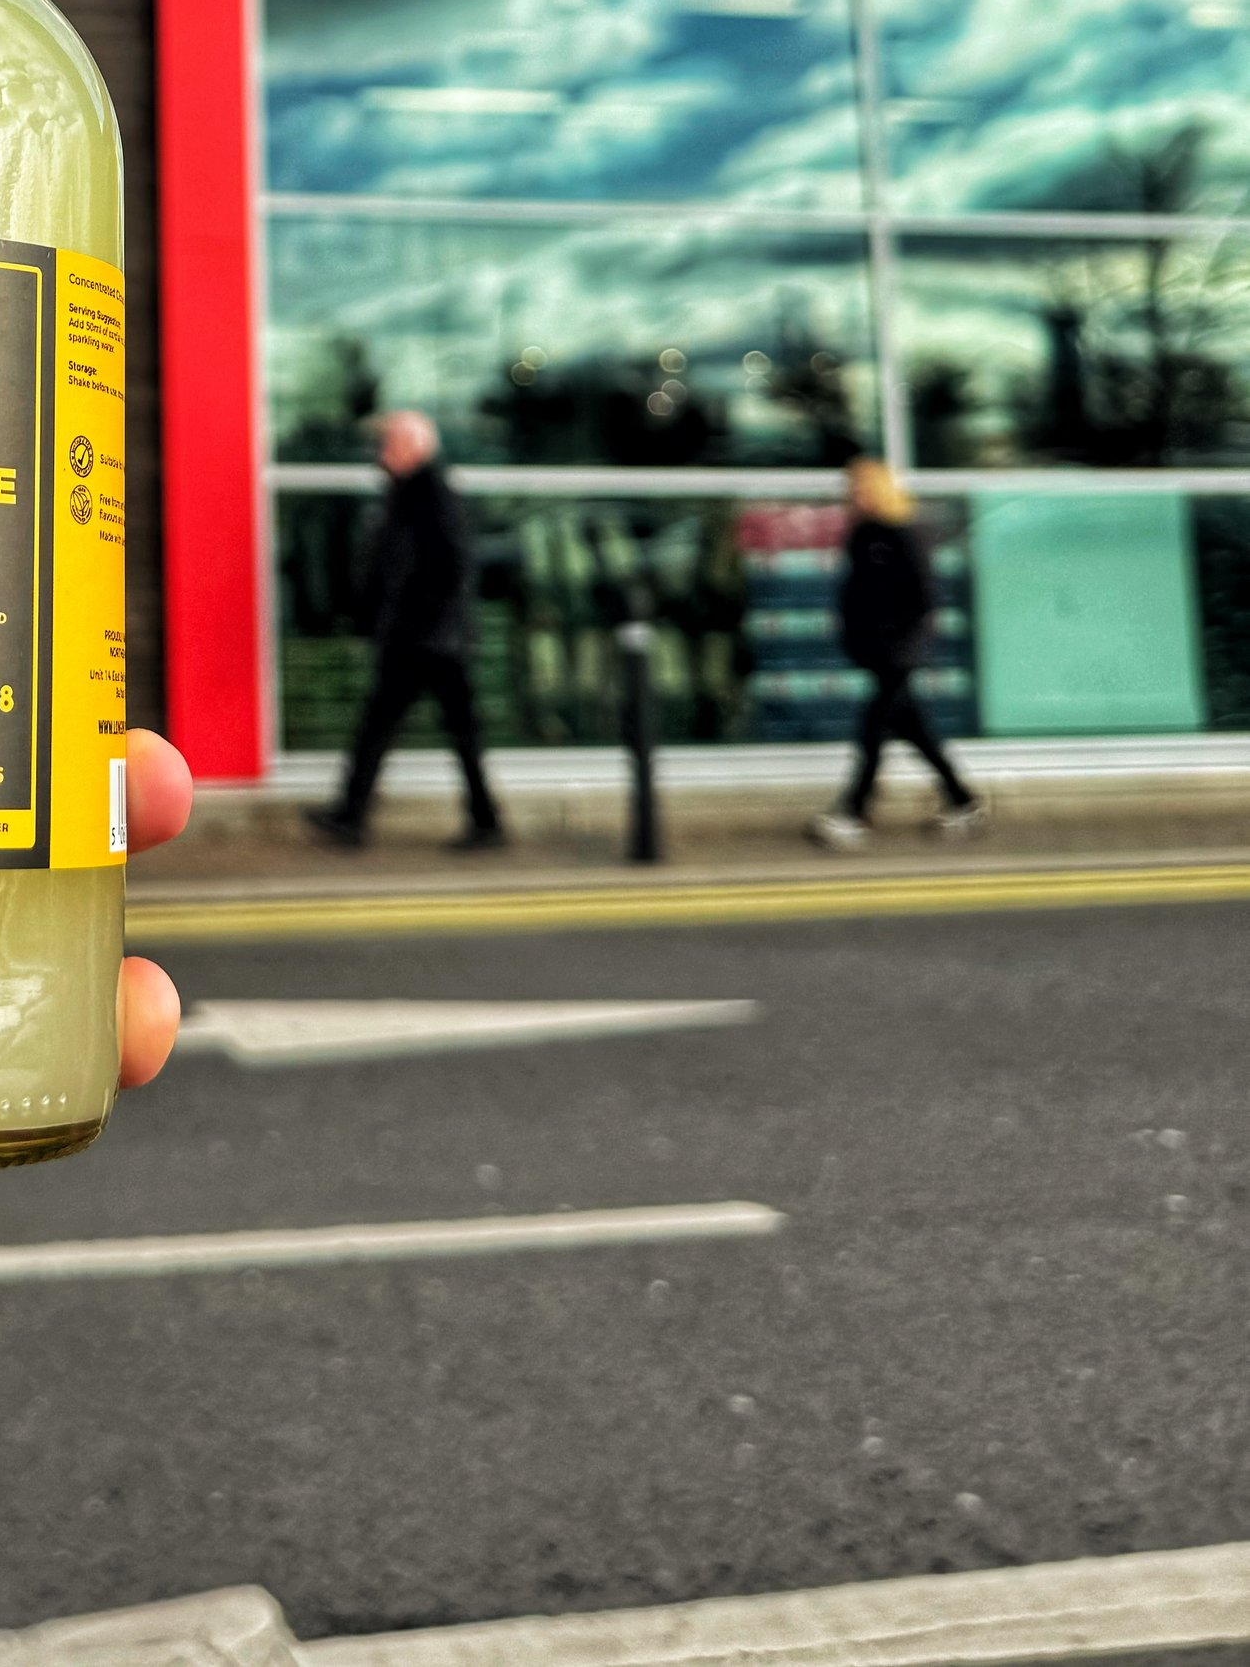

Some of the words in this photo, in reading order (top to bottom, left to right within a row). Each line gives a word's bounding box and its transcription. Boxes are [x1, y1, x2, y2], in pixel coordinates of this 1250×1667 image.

[68, 302, 96, 321] Serving
[68, 317, 85, 330] Add
[68, 333, 100, 350] sparkling
[68, 375, 91, 390] Shake
